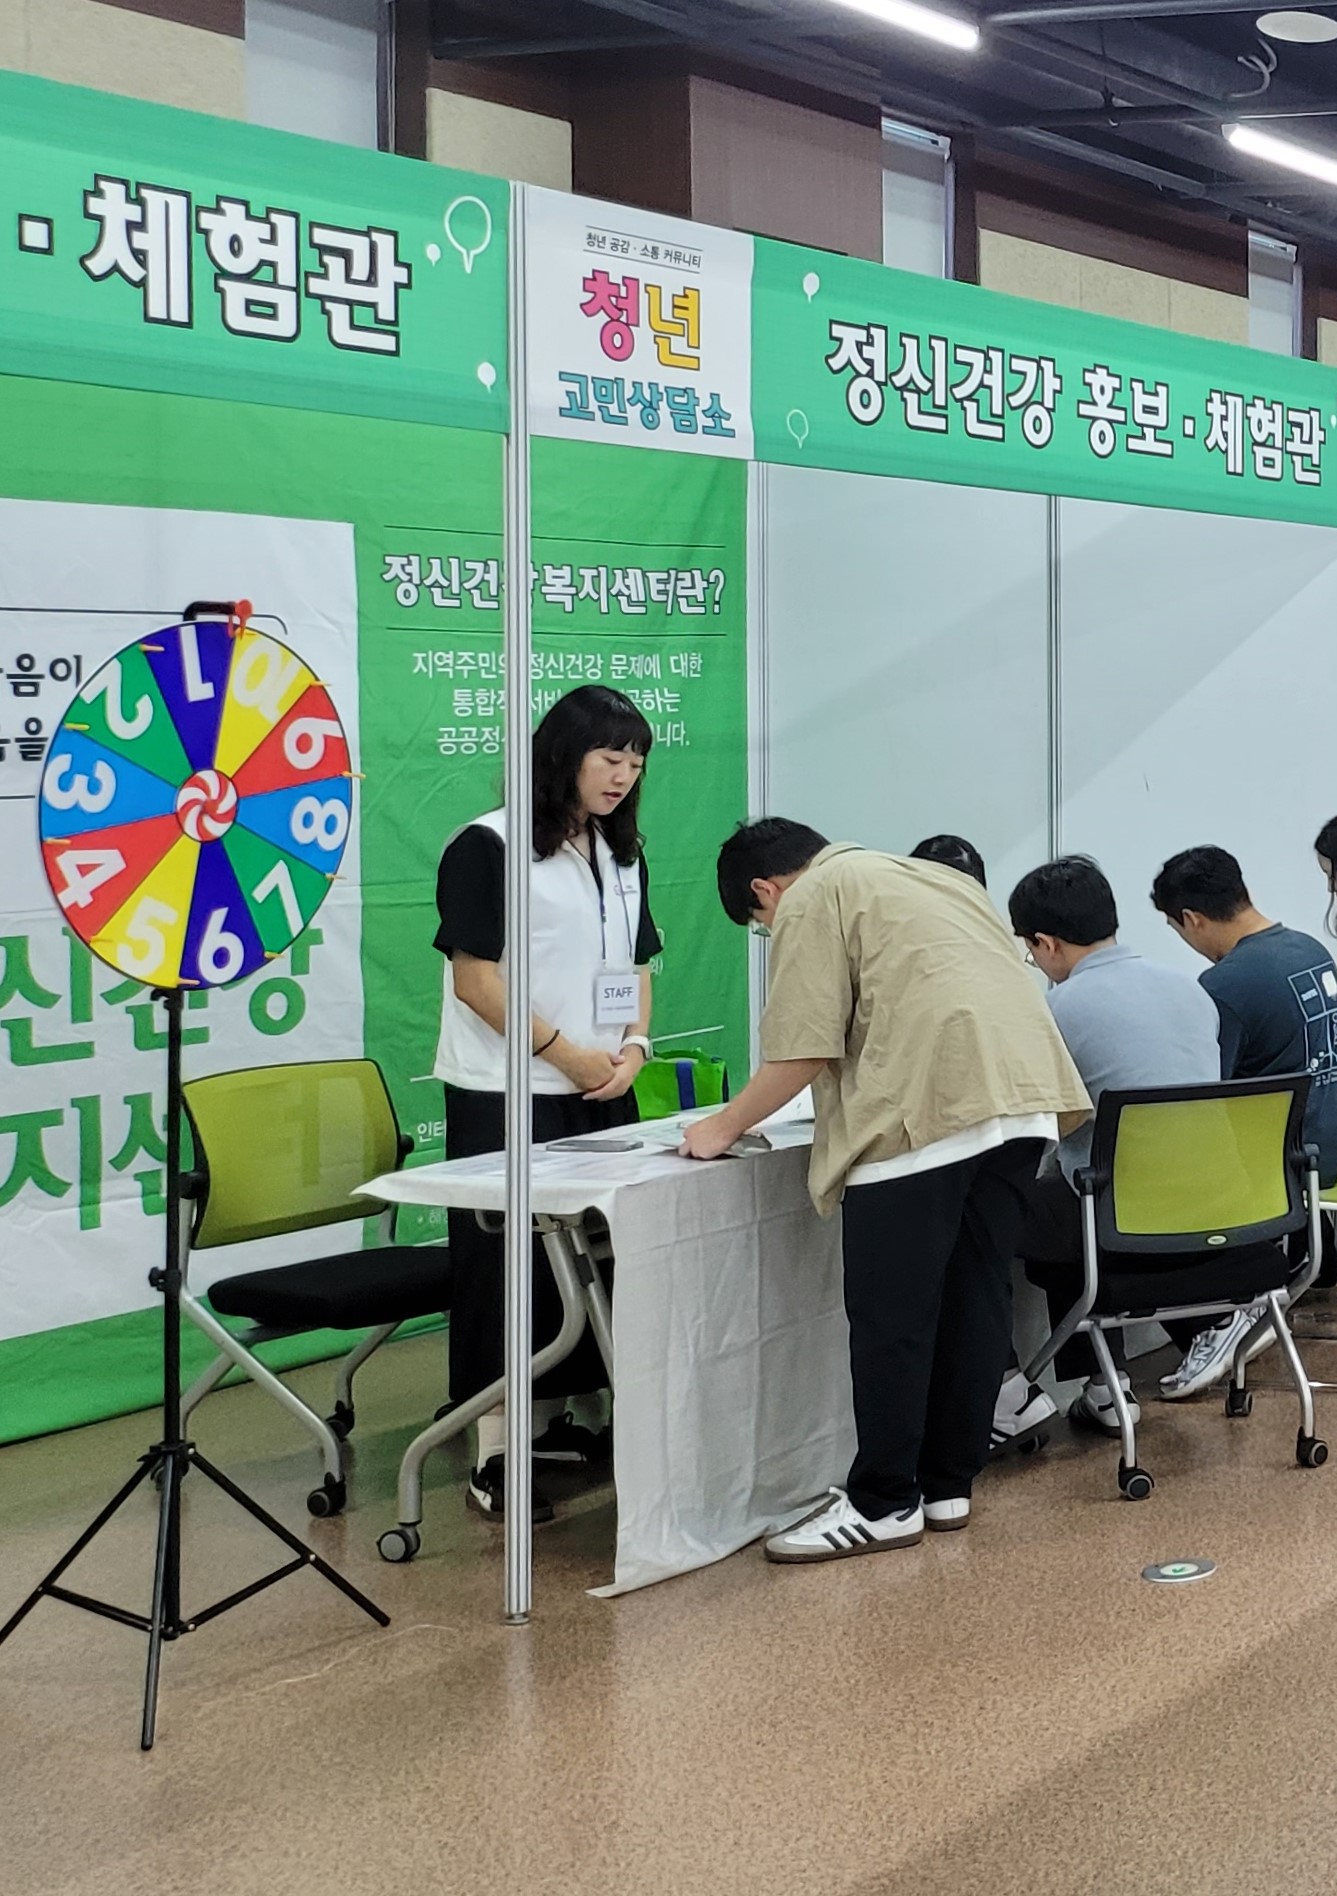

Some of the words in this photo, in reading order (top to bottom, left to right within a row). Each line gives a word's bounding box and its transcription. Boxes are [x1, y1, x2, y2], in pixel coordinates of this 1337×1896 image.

[586, 232, 606, 249] 청년
[610, 237, 630, 253] 공감
[640, 244, 660, 260] 소통
[663, 249, 701, 268] 커뮤니티
[580, 269, 700, 371] 청년
[558, 371, 736, 438] 고민상담소
[825, 319, 1062, 448] 정신건강
[0, 653, 82, 697] 음이
[610, 653, 661, 680] 문제에
[670, 652, 702, 678] 대한
[80, 658, 154, 740] 2
[43, 753, 117, 814] 3
[290, 796, 349, 852] 8
[56, 848, 127, 909] 4
[252, 860, 306, 937] 7
[117, 897, 178, 976] 5
[199, 907, 244, 984] 6
[604, 987, 633, 999] STAFF
